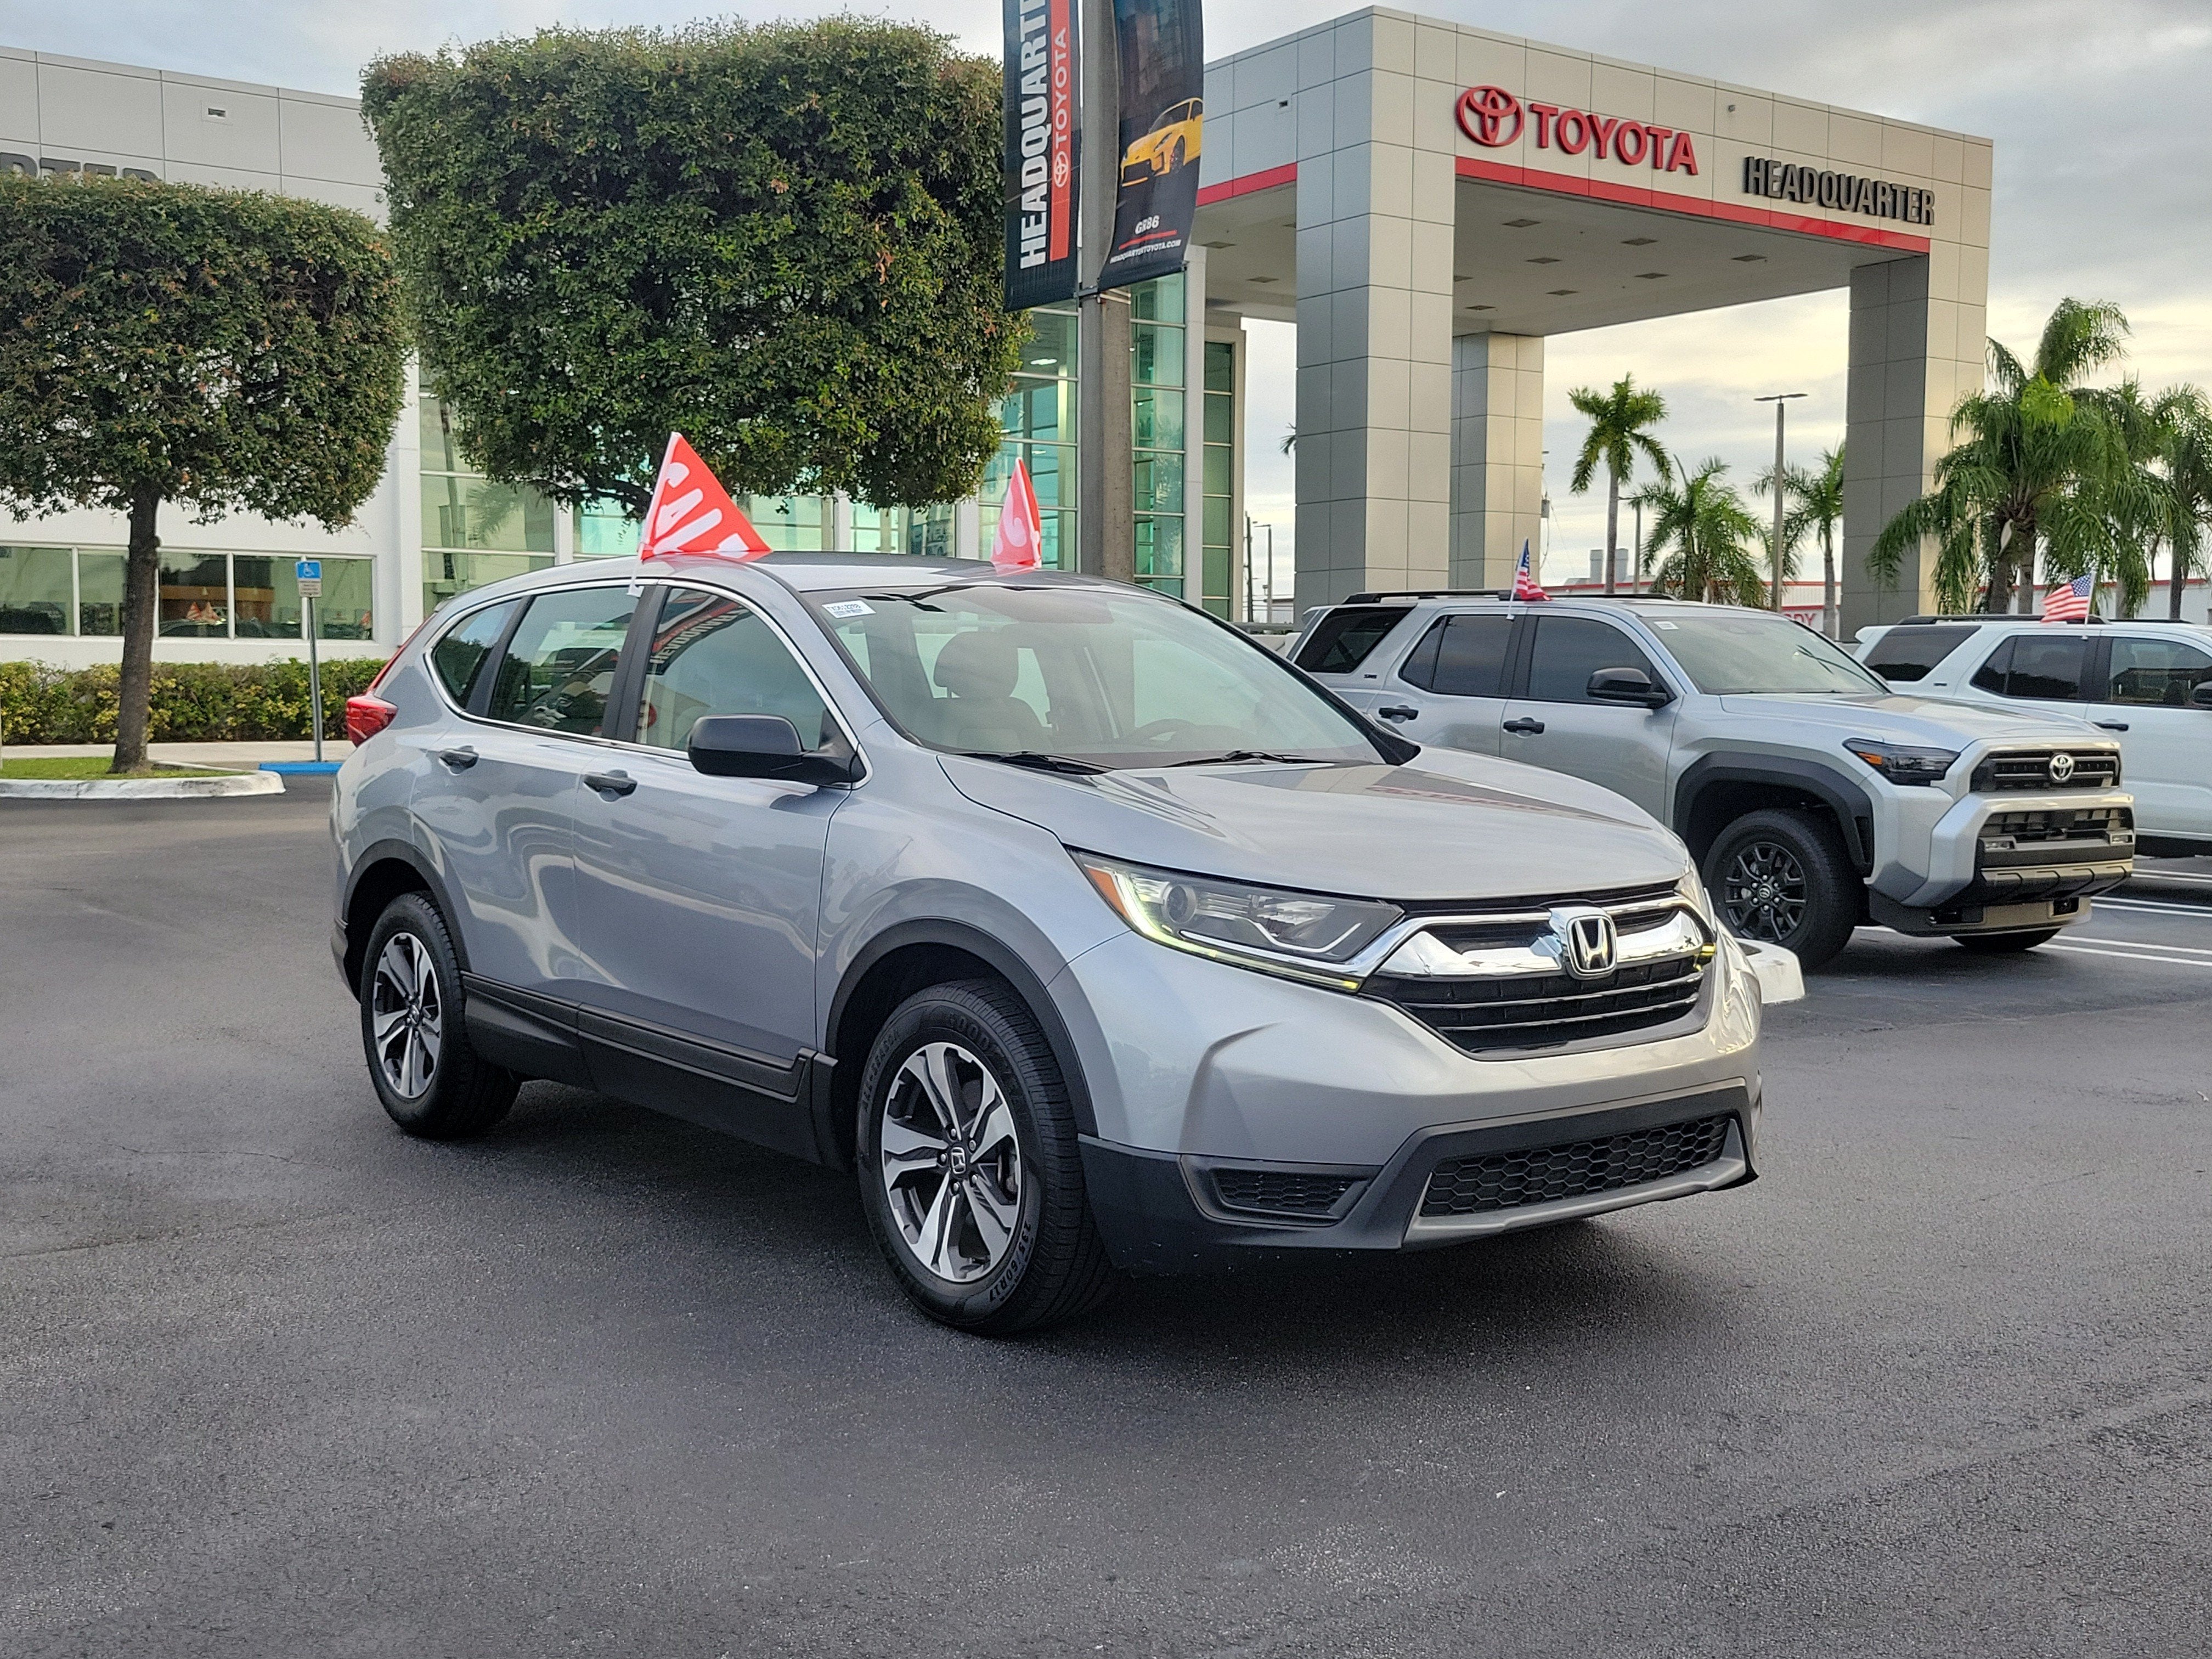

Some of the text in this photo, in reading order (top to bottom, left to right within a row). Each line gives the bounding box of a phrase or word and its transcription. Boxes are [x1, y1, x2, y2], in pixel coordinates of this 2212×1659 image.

[1054, 27, 1068, 150] TOYOTA
[1529, 103, 1699, 176] TOYOTA
[1744, 156, 1936, 225] HEADQUARTER
